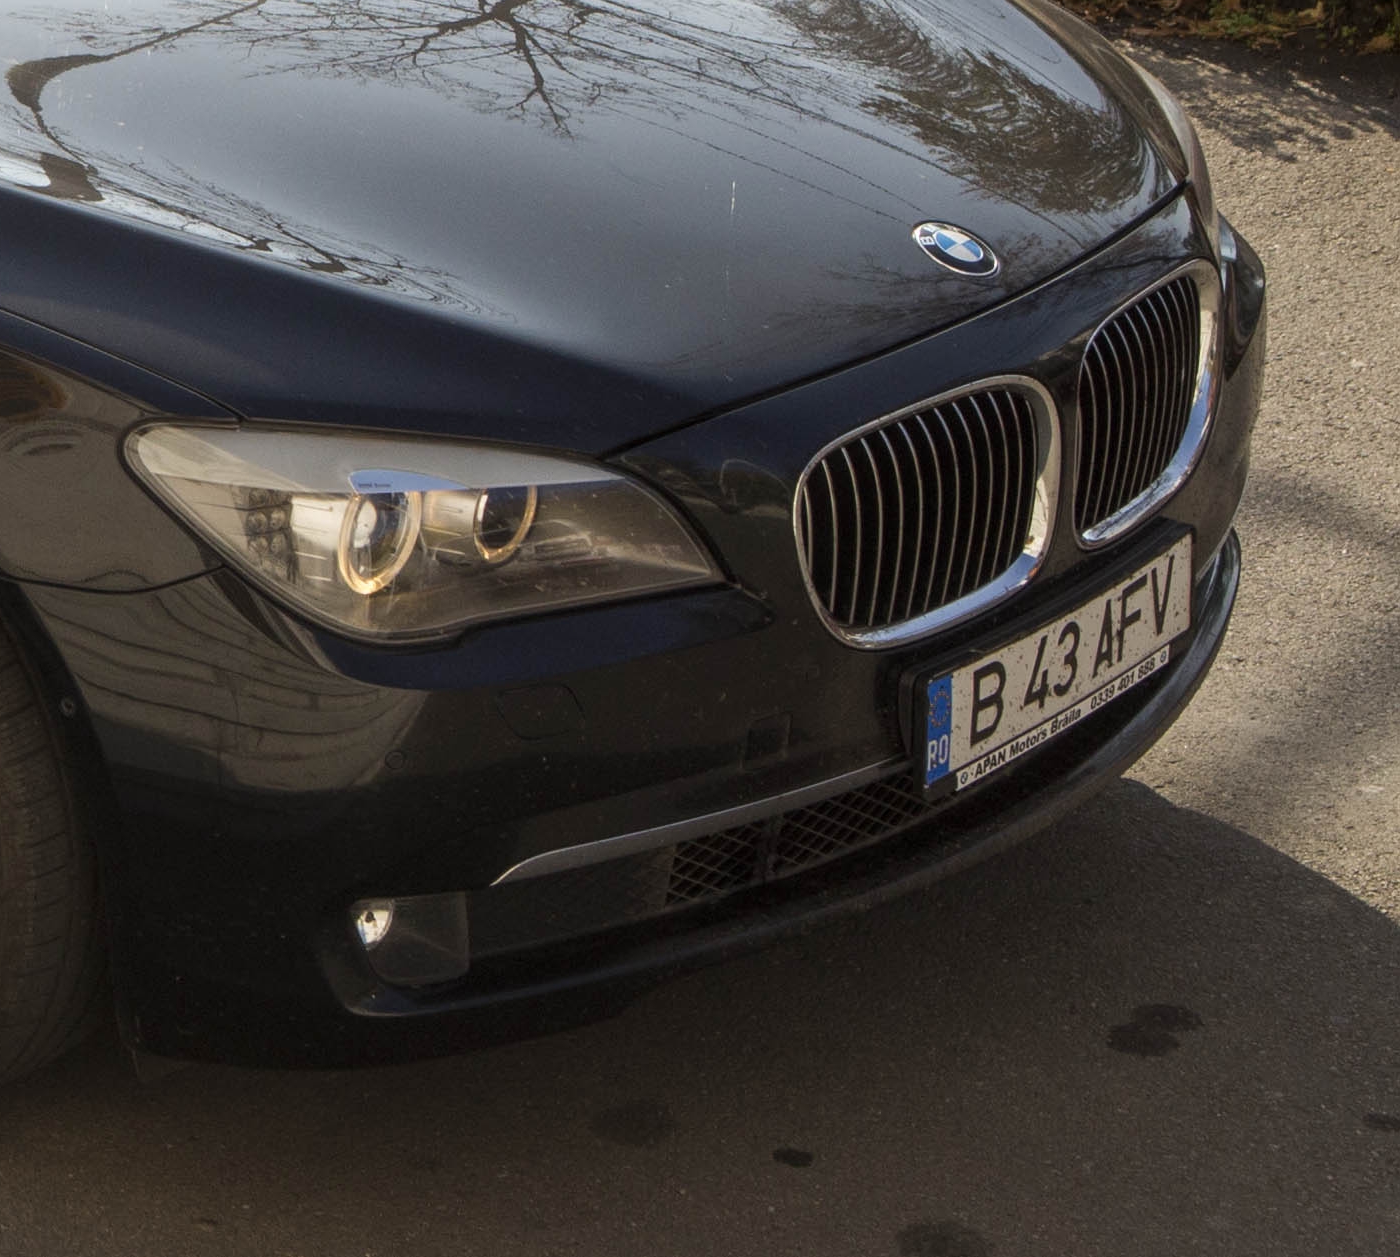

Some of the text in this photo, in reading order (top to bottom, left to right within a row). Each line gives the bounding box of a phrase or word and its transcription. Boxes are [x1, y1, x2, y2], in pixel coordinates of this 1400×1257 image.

[970, 555, 1176, 747] B 43 AFV
[927, 734, 949, 772] RO
[974, 748, 1006, 778] APAN
[1009, 728, 1048, 758] Motors
[1090, 684, 1115, 710] 0339
[1117, 671, 1135, 692] 401
